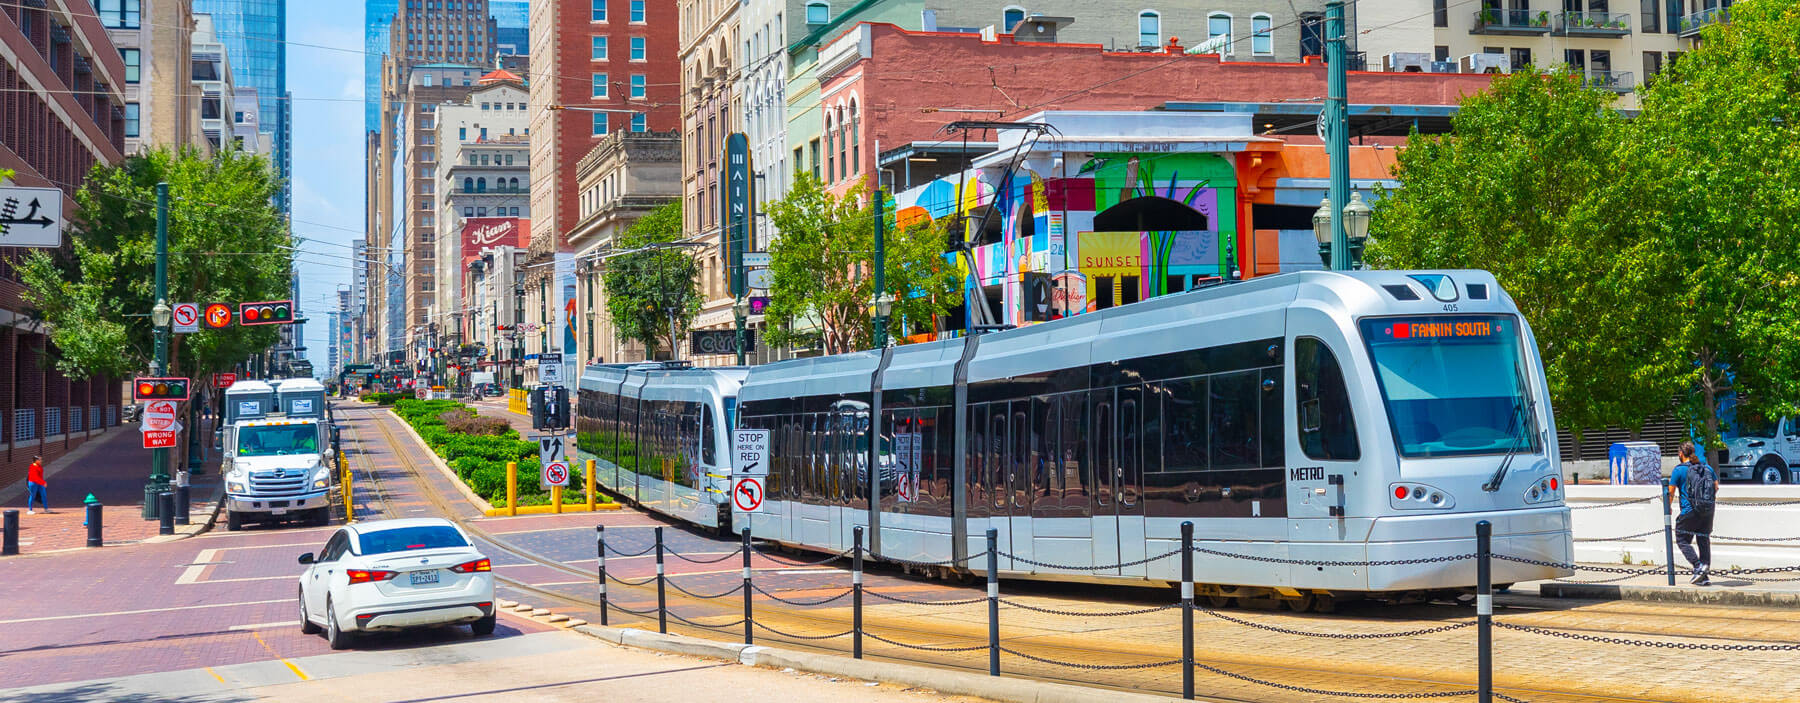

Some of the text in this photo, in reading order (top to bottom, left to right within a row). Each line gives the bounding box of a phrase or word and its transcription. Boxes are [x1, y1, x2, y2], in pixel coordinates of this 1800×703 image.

[471, 221, 511, 245] Kiam
[1086, 256, 1141, 268] SUNSET
[1442, 303, 1459, 312] 405
[1411, 321, 1491, 337] FANNIN SOUTH
[147, 431, 173, 439] WRONG
[738, 433, 764, 443] STOP
[152, 438, 168, 446] WAY
[740, 452, 760, 461] RED
[1290, 466, 1324, 481] METRO
